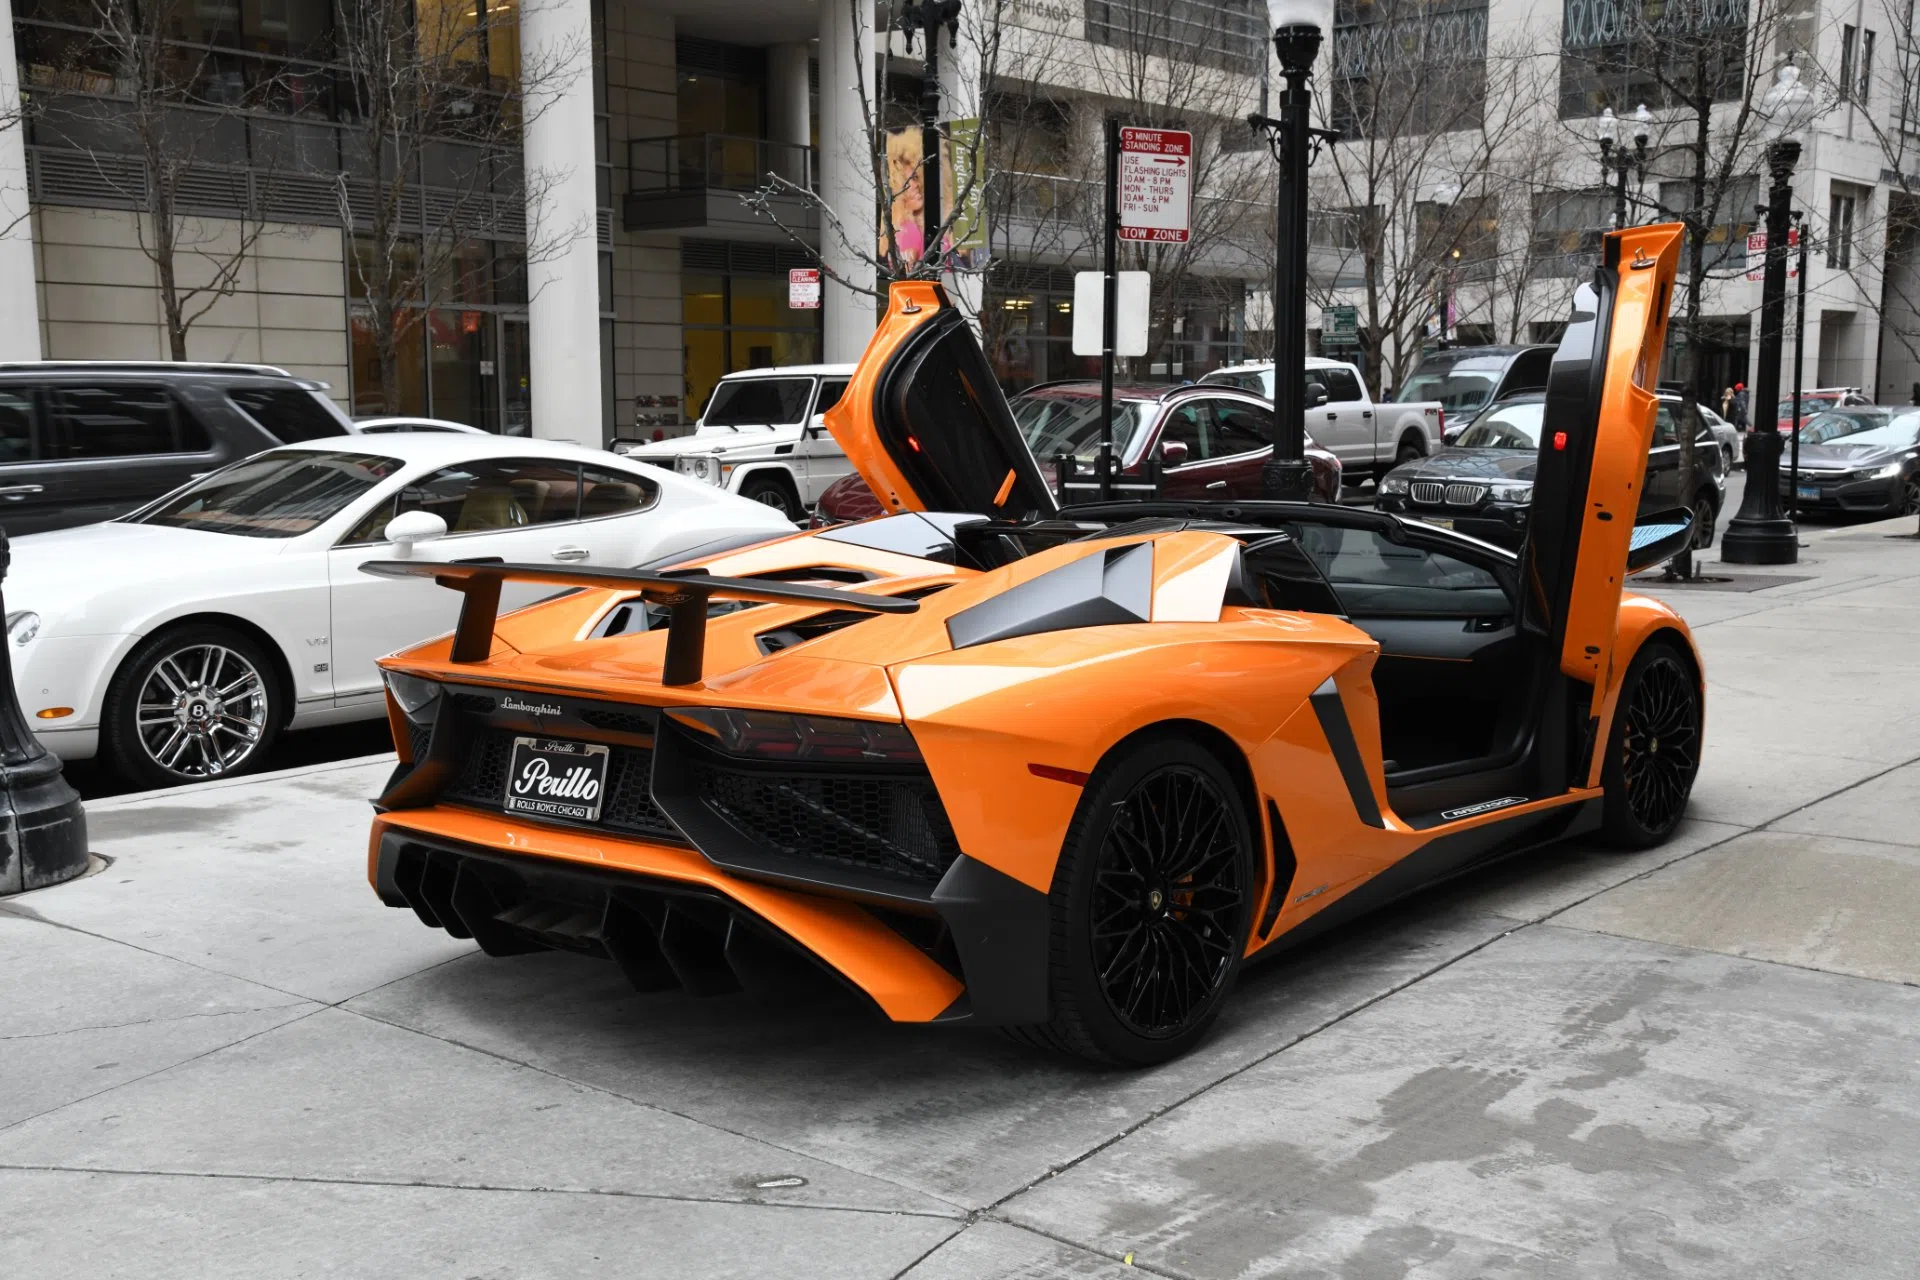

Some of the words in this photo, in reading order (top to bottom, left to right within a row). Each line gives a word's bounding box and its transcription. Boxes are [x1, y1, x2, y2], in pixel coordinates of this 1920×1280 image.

[1013, 0, 1070, 22] CHICAGO
[1125, 131, 1133, 140] 15
[1135, 132, 1162, 142] MINUTE
[1125, 142, 1160, 152] STANDING
[1164, 145, 1184, 154] ZONE
[1125, 156, 1140, 165] USE
[1124, 166, 1160, 176] FLASHING
[1161, 170, 1187, 178] LIGHTS
[953, 146, 969, 221] Englewd
[1124, 175, 1132, 183] 10
[1132, 175, 1145, 183] AM
[1160, 177, 1171, 186] PM
[1124, 185, 1141, 193] MON
[1149, 186, 1174, 195] THURS
[1124, 193, 1132, 201] 10
[1132, 194, 1144, 202] AM
[1152, 196, 1157, 204] 6
[1159, 196, 1170, 204] PM
[1123, 203, 1136, 211] FRI
[1143, 203, 1159, 212] SUN
[1123, 227, 1147, 239] TOW
[1153, 230, 1183, 241] ZONE
[500, 696, 562, 715] Lamborghini
[544, 740, 575, 753] Perillo
[514, 757, 599, 800] Perillo
[516, 799, 536, 811] ROLLS
[536, 801, 557, 814] ROYCE
[557, 804, 585, 817] CHICAGO
